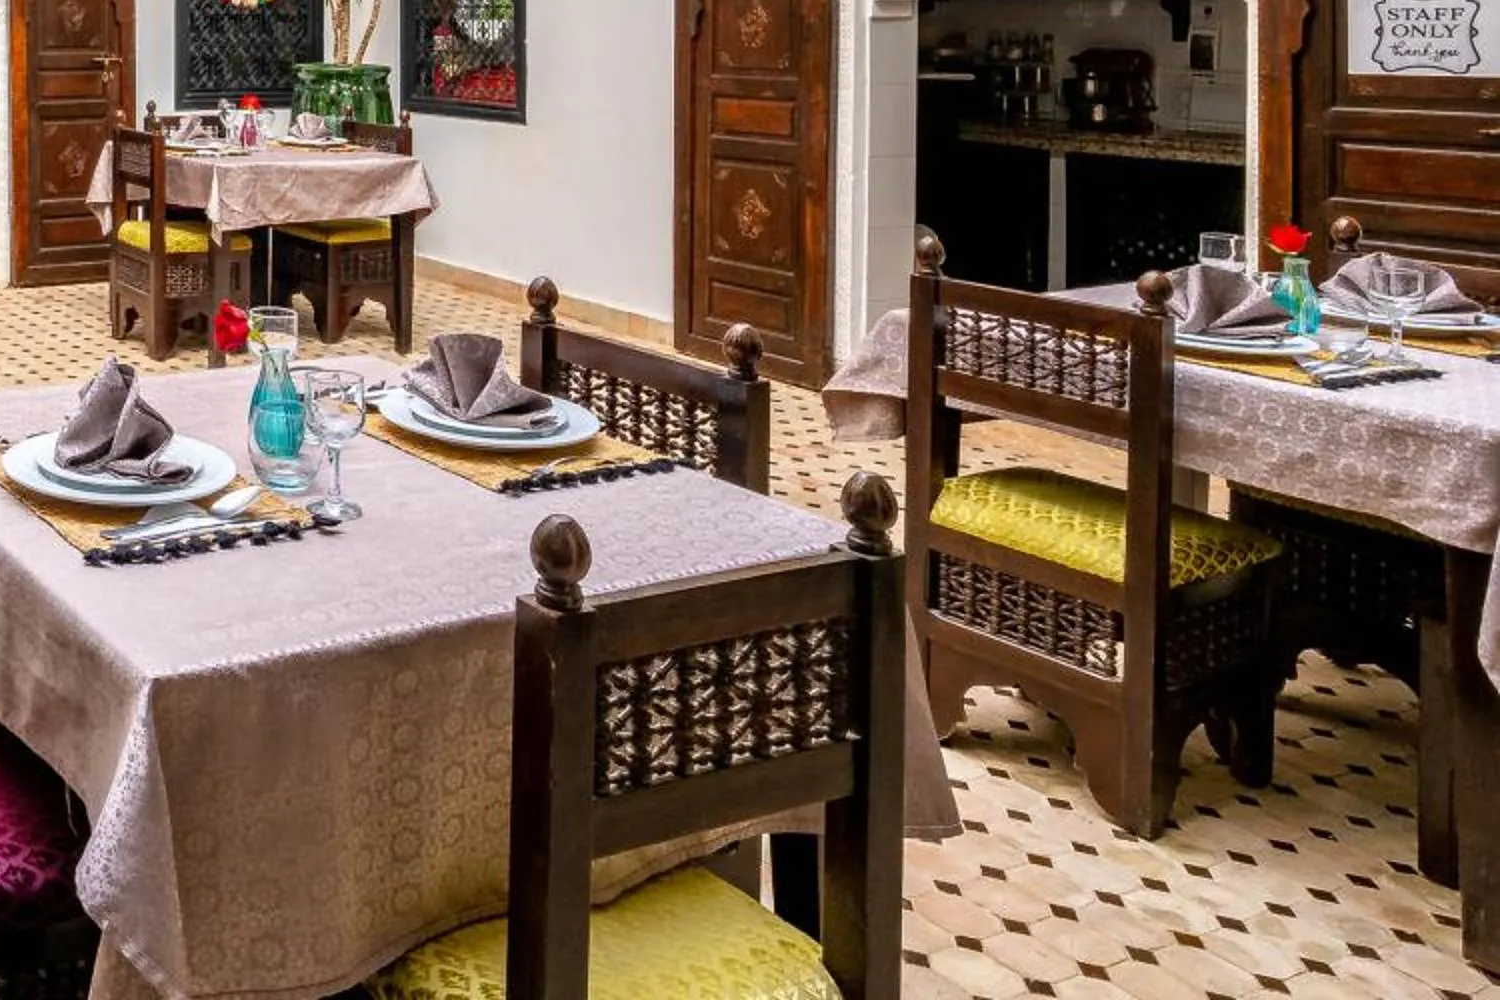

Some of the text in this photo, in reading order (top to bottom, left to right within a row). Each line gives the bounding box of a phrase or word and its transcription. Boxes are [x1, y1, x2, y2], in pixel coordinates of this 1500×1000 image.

[1387, 7, 1465, 21] STAFF
[1391, 23, 1461, 39] ONLY
[1428, 48, 1460, 62] you
